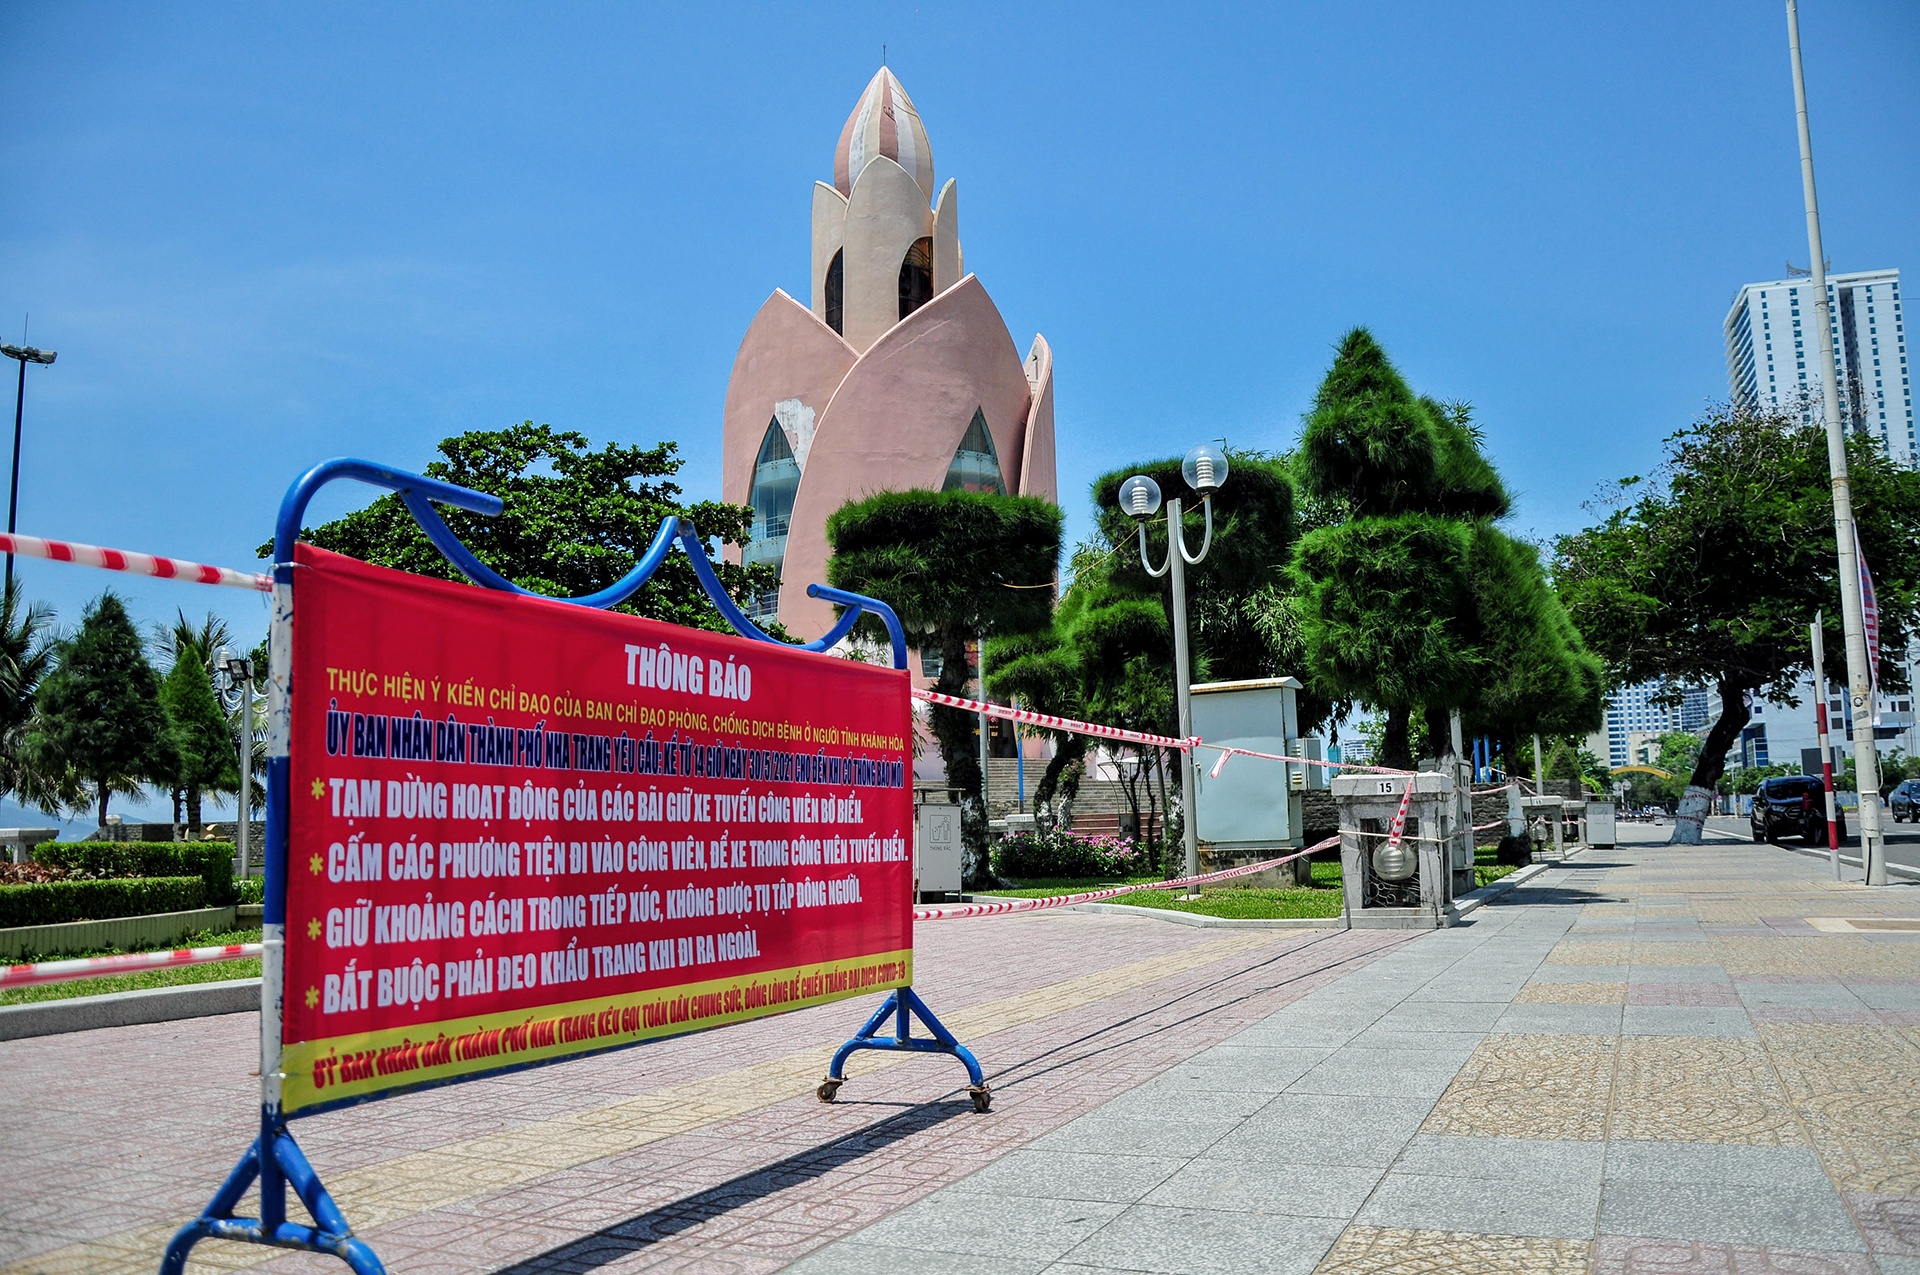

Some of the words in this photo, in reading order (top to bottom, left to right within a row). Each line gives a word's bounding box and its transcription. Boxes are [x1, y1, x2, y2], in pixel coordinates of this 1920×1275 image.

[326, 667, 378, 698] THỰC
[384, 671, 425, 703] HIỆN
[431, 675, 441, 702] Ý
[447, 677, 485, 707] KIẾN
[489, 684, 515, 711] CHỈ
[519, 692, 550, 717] ĐẠO
[553, 690, 582, 718] CỦA
[586, 700, 613, 721] BAN
[616, 699, 637, 724] CHỈ
[640, 706, 666, 729] ĐẠO
[668, 707, 710, 734] PHÒNG,
[713, 711, 749, 735] CHỐNG
[752, 720, 775, 740] DỊCH
[777, 720, 802, 743] BỆNH
[804, 720, 811, 742] Ở
[813, 726, 839, 745] NGƯỜI
[841, 726, 859, 747] TỈNH
[861, 731, 887, 750] KHÁNH
[888, 733, 905, 751] HÒA
[624, 642, 704, 695] THÔNG
[709, 654, 752, 702] BÁO
[326, 697, 351, 756] ỦY
[353, 713, 388, 759] BAN
[390, 710, 433, 761] NHÂN
[435, 713, 466, 764] DÂN
[468, 716, 515, 766] THÀNH
[516, 719, 547, 769] PHỐ
[545, 731, 571, 771] NHA
[572, 733, 612, 773] TRANG
[613, 730, 636, 775] YÊU
[678, 736, 693, 777] TỪ
[693, 744, 705, 777] 14
[706, 739, 723, 779] GIỜ
[723, 741, 748, 780] NGÀY
[749, 748, 794, 782] 30/5/2021
[795, 753, 811, 784] CHO
[812, 747, 827, 785] ĐẾN
[828, 756, 842, 786] KHI
[843, 751, 853, 786] CÓ
[853, 753, 876, 788] THÔNG
[876, 754, 890, 788] BÁO
[329, 778, 381, 826] TẠM
[386, 772, 447, 819] DỪNG
[452, 784, 505, 827] HOẠT
[508, 779, 559, 828] ĐỘNG
[563, 779, 598, 821] CỦA
[601, 783, 634, 822] CÁC
[637, 784, 663, 822] BÃI
[666, 785, 693, 823] GIỮ
[693, 793, 711, 822] XE
[714, 787, 756, 823] TUYẾN
[758, 791, 790, 823] CÔNG
[792, 792, 819, 823] VIÊN
[821, 792, 836, 824] BỜ
[837, 790, 864, 824] BIỂN.
[1380, 782, 1392, 793] 15
[328, 831, 382, 883] CẤM
[388, 834, 434, 881] CÁC
[439, 836, 520, 879] PHƯƠNG
[524, 835, 566, 882] TIỆN
[569, 841, 587, 874] ĐI
[591, 834, 624, 873] VÀO
[627, 835, 668, 873] CÔNG
[671, 835, 707, 871] VIÊN,
[710, 829, 728, 869] ĐỂ
[730, 840, 747, 868] XE
[749, 840, 789, 867] TRONG
[791, 834, 821, 866] CÔNG
[823, 834, 848, 864] VIÊN
[849, 832, 881, 863] TUYẾN
[882, 829, 909, 862] BIỂN.
[326, 898, 372, 949] GIỮ
[374, 892, 465, 944] KHOẢNG
[470, 891, 523, 937] CÁCH
[527, 894, 586, 931] TRONG
[590, 884, 627, 926] TIẾP
[629, 884, 664, 923] XÚC,
[666, 882, 714, 920] KHÔNG
[717, 881, 752, 919] ĐƯỢC
[754, 884, 770, 916] TỤ
[772, 877, 795, 915] TẬP
[796, 876, 826, 908] ĐÔNG
[828, 873, 863, 906] NGƯỜI.
[323, 958, 373, 1014] BẮT
[377, 957, 439, 1011] BUỘC
[445, 948, 493, 998] PHẢI
[497, 953, 537, 991] ĐEO
[541, 936, 589, 986] KHẨU
[592, 942, 646, 978] TRANG
[649, 939, 676, 971] KHI
[678, 936, 693, 967] ĐI
[696, 935, 715, 964] RA
[717, 924, 761, 962] NGOÀI.
[312, 1047, 338, 1089] ỦY
[340, 1049, 376, 1083] BAN
[376, 1038, 423, 1076] NHÂN
[421, 1032, 455, 1067] DÂN
[455, 1026, 500, 1062] THÀNH
[502, 1015, 534, 1054] PHỐ
[530, 1020, 556, 1048] NHA
[558, 1012, 596, 1044] TRANG
[598, 1005, 621, 1037] KÊU
[622, 1005, 640, 1036] GỌI
[642, 997, 668, 1028] TOÀN
[670, 993, 690, 1024] DÂN
[691, 992, 722, 1020] CHUNG
[724, 984, 744, 1013] SỨC,
[769, 977, 788, 1005] LÒNG
[789, 970, 800, 1001] ĐỂ
[801, 969, 823, 999] CHIẾN
[825, 965, 847, 994] THẮNG
[848, 968, 860, 993] ĐẠI
[861, 966, 876, 990] DỊCH
[878, 960, 906, 984] COVID-19
